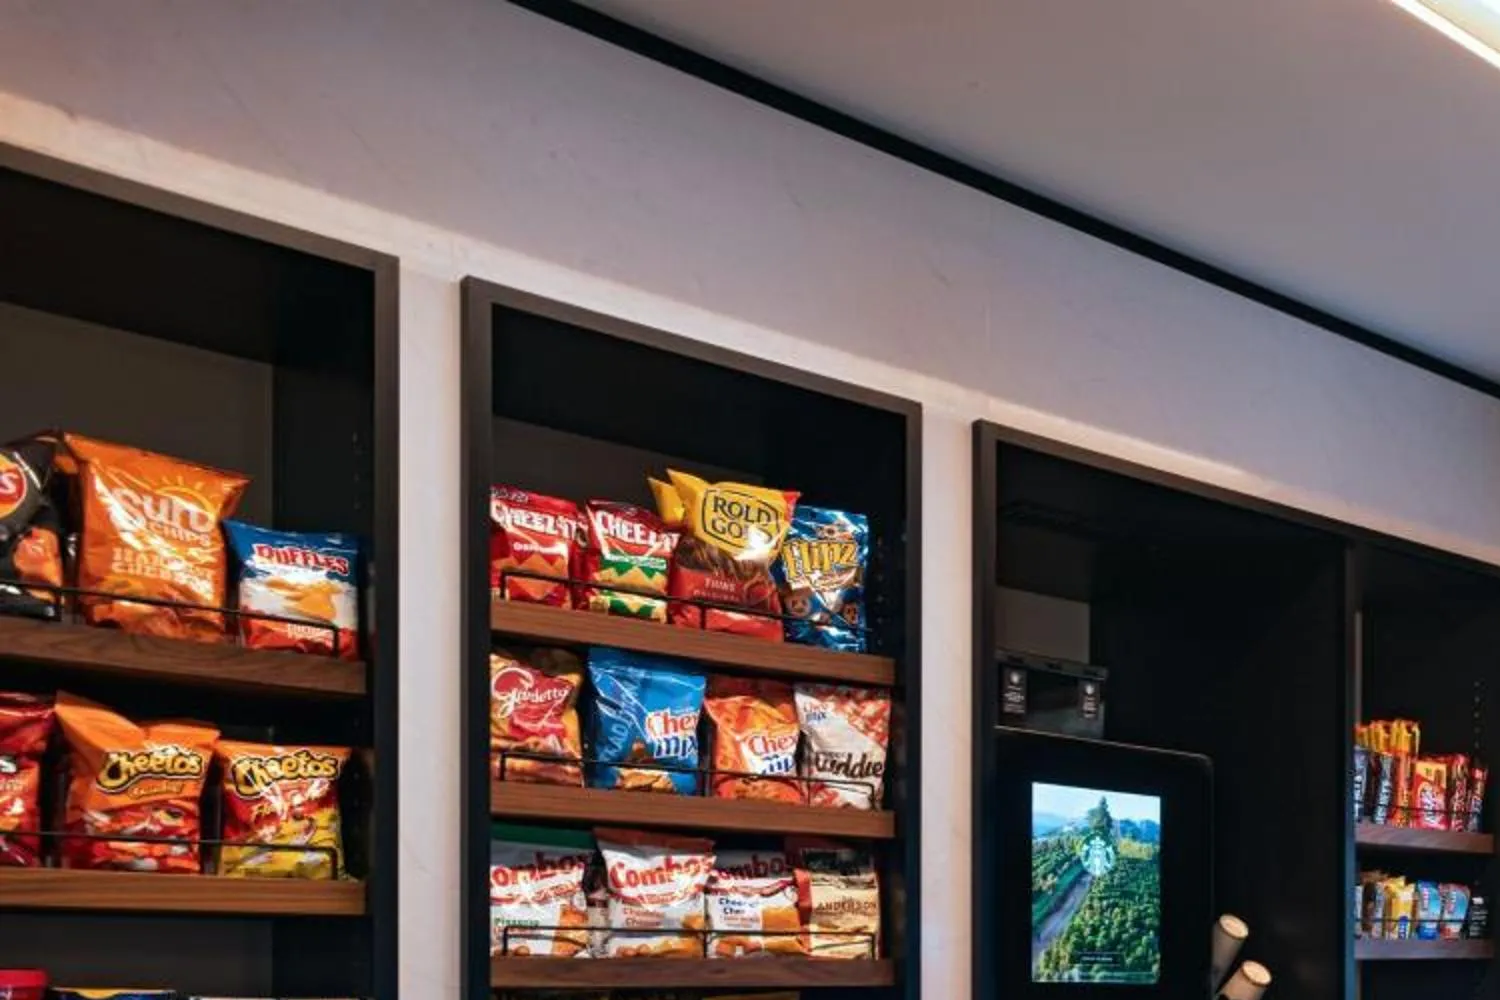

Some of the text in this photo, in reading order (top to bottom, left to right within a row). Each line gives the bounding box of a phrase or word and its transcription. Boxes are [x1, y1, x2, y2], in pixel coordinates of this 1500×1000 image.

[713, 495, 771, 526] ROLD
[253, 544, 349, 575] RUFFLES
[97, 746, 205, 788] Cheetos
[230, 750, 341, 797] Cheetos
[608, 854, 716, 890] Combos
